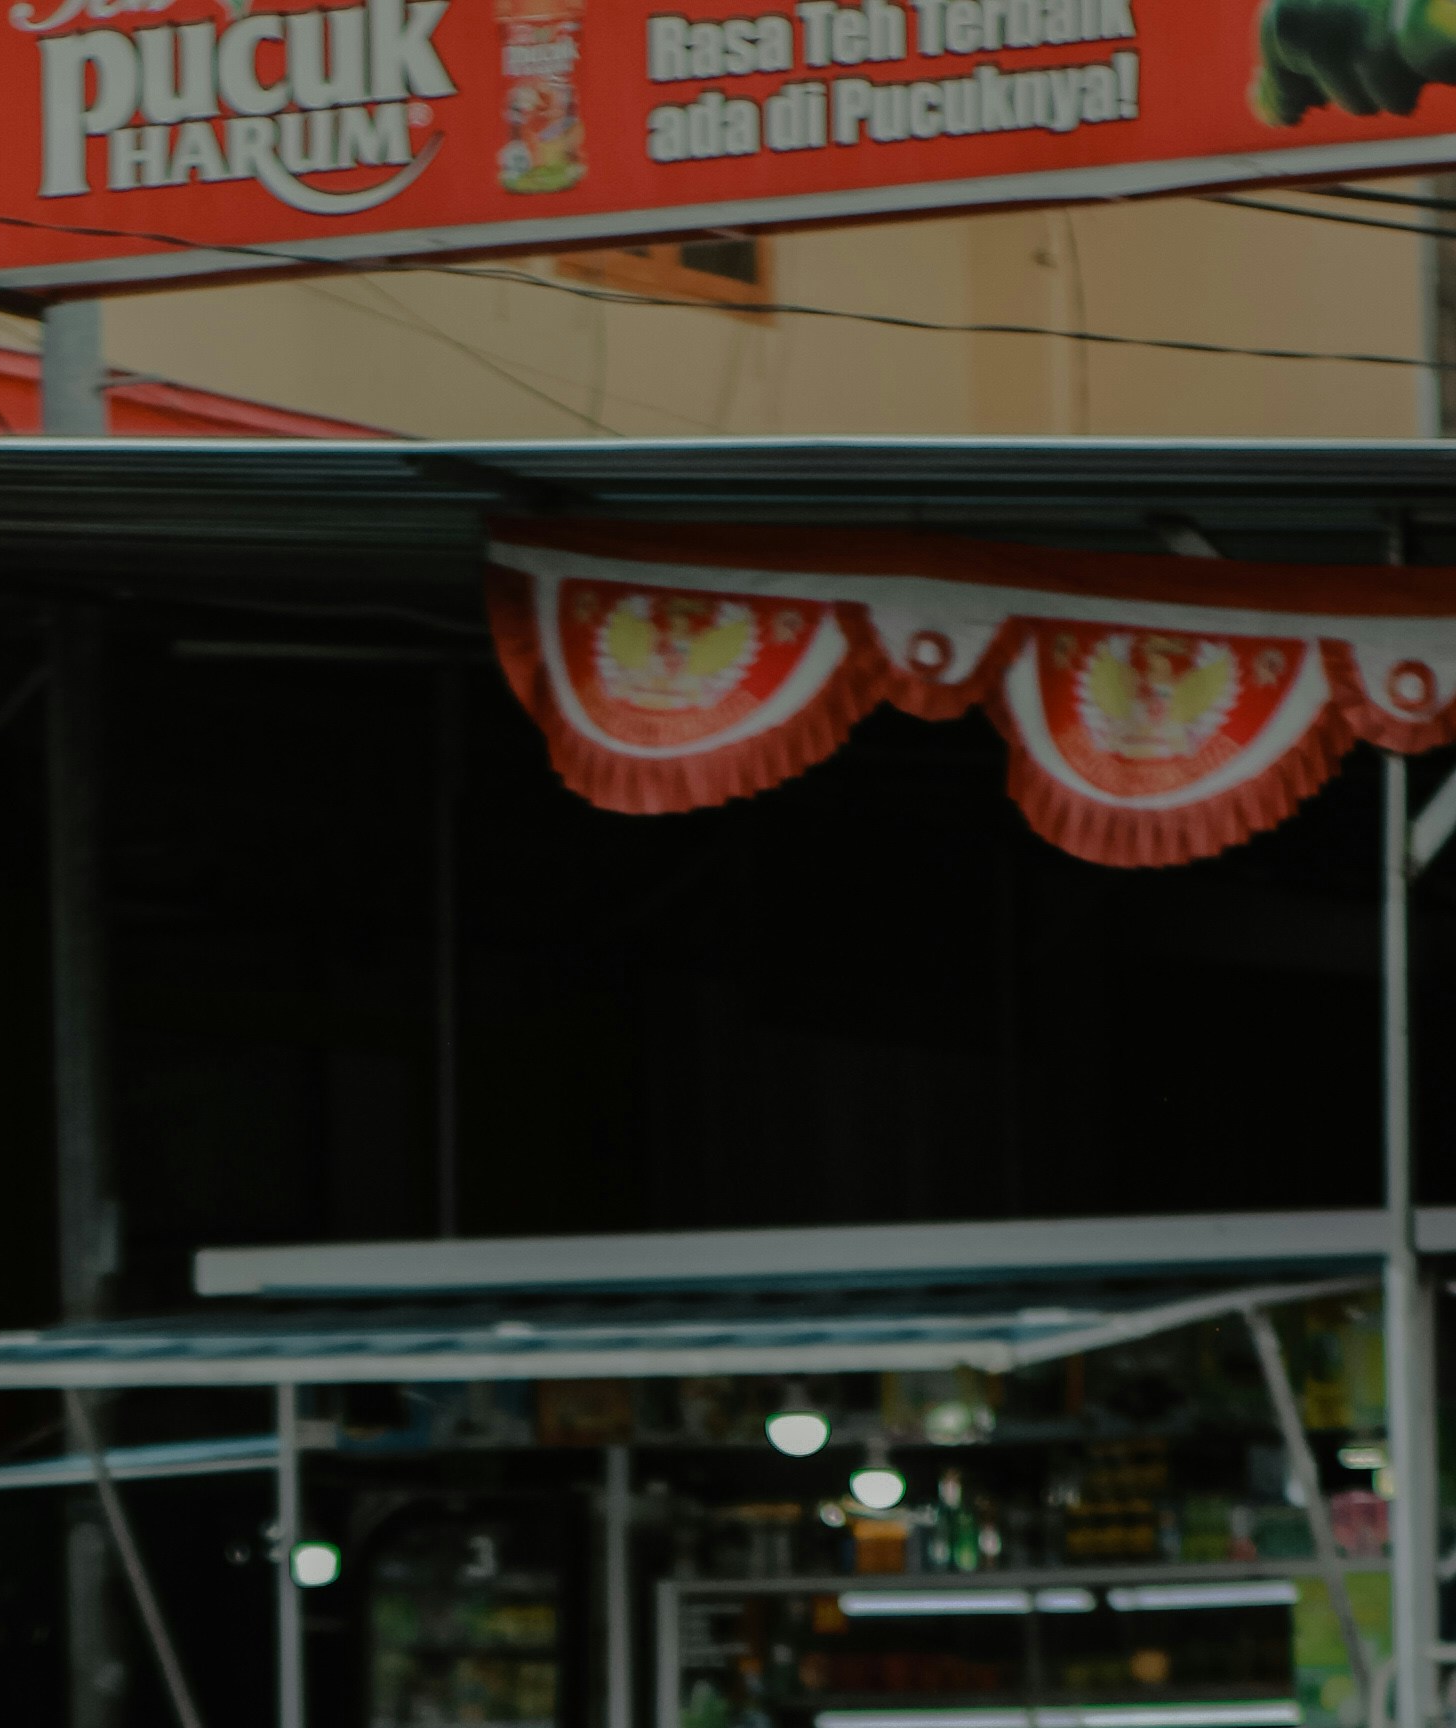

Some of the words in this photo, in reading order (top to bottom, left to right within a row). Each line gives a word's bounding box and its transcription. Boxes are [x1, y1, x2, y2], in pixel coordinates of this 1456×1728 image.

[647, 14, 793, 84] Rasa
[796, 0, 907, 67] Teh
[107, 103, 444, 214] HARUM
[647, 87, 762, 164] ada
[764, 78, 829, 155] di
[831, 48, 1140, 148] Pucuknya!
